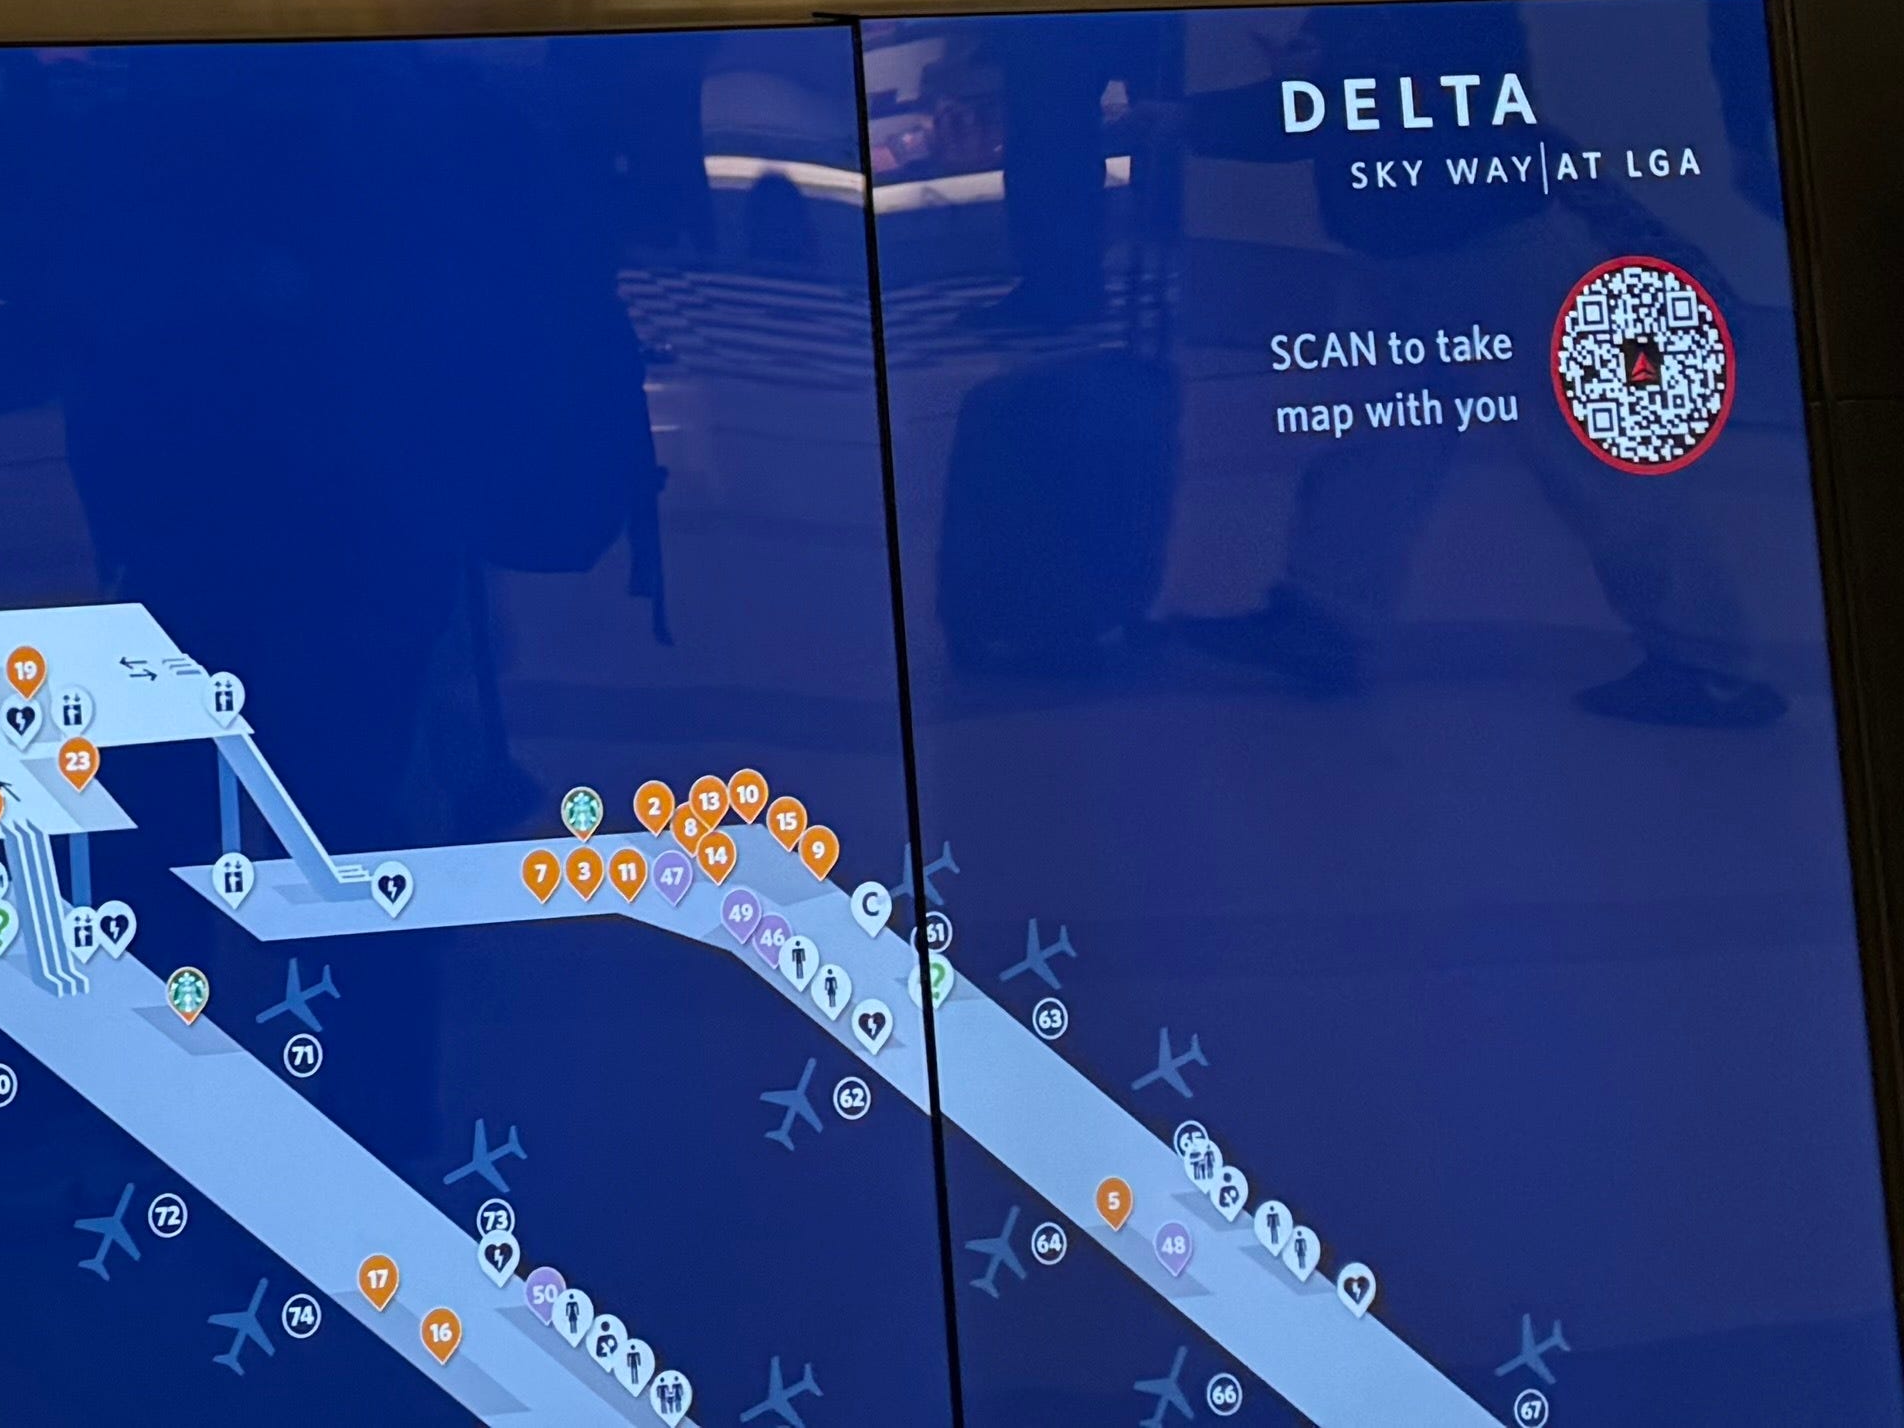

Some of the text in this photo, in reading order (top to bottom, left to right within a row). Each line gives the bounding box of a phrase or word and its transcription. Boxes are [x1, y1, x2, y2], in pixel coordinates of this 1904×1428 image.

[1282, 73, 1537, 132] DELTA
[1351, 148, 1700, 189] SKY WAY AT LGA
[292, 1045, 314, 1065] 71
[840, 1088, 865, 1109] 62
